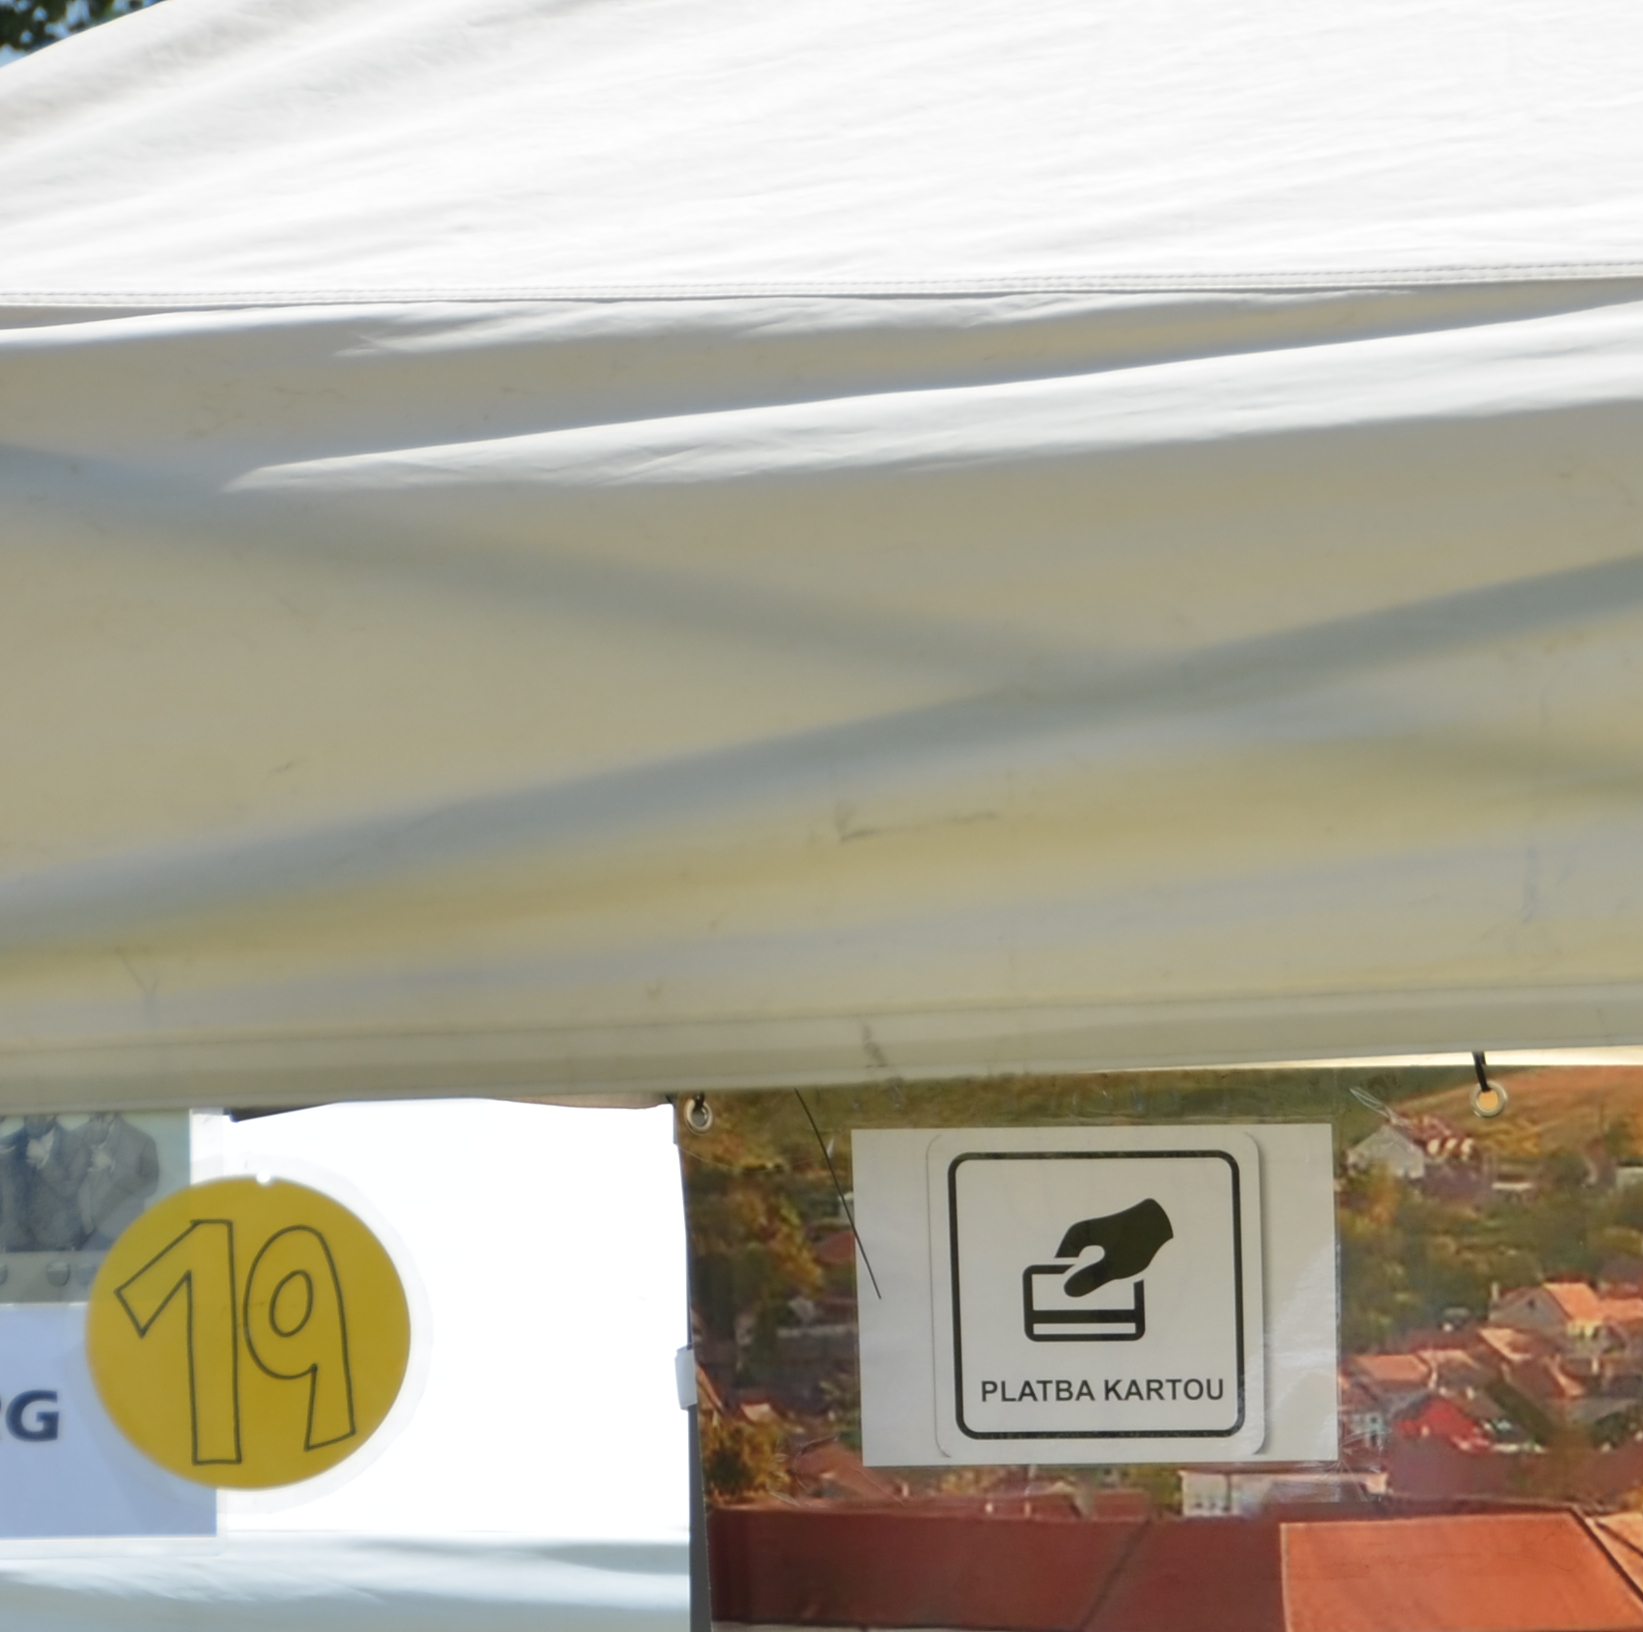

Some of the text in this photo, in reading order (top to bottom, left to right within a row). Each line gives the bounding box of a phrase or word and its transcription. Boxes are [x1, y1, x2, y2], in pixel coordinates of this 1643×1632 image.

[114, 1218, 356, 1465] 19
[0, 1389, 60, 1442] G
[981, 1378, 1224, 1402] PLATBA KARTOU
